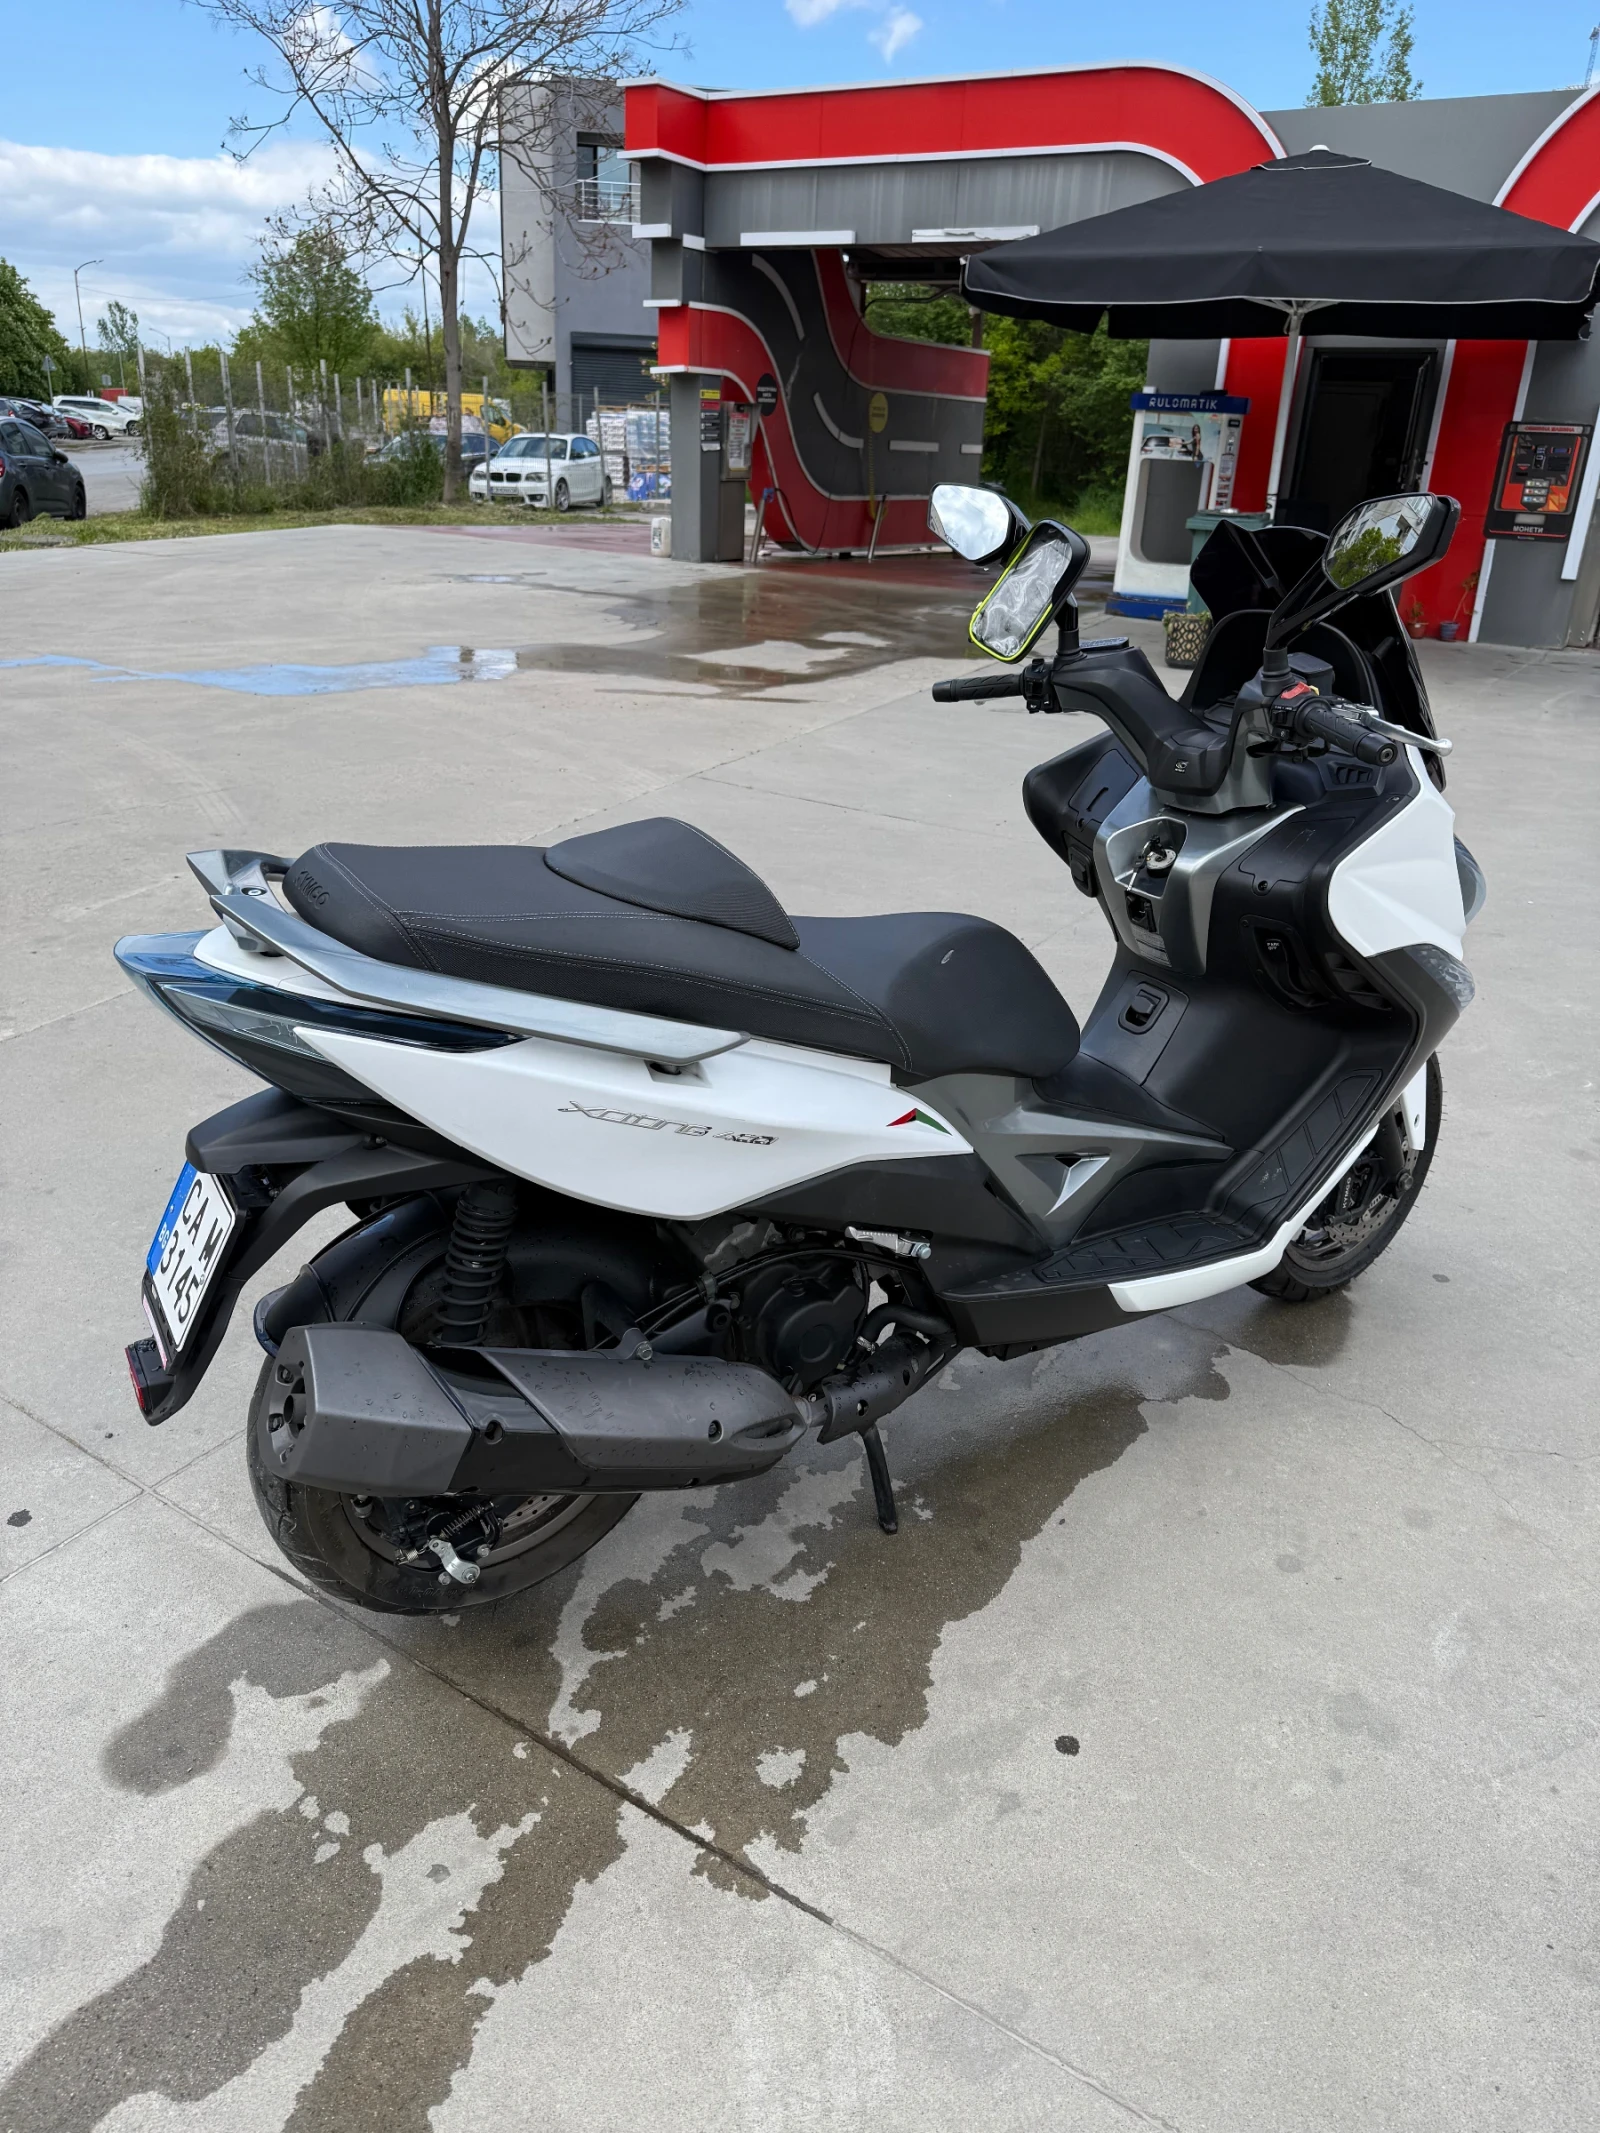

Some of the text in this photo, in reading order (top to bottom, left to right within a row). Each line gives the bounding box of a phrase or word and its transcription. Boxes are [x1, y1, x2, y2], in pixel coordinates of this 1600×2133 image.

[1149, 397, 1218, 410] RULOMATIK
[1512, 525, 1544, 534] МОНЕТИ
[1342, 1176, 1352, 1209] KYMCO
[158, 1221, 170, 1250] BG
[182, 1178, 224, 1273] CA M
[160, 1229, 200, 1324] 3145
